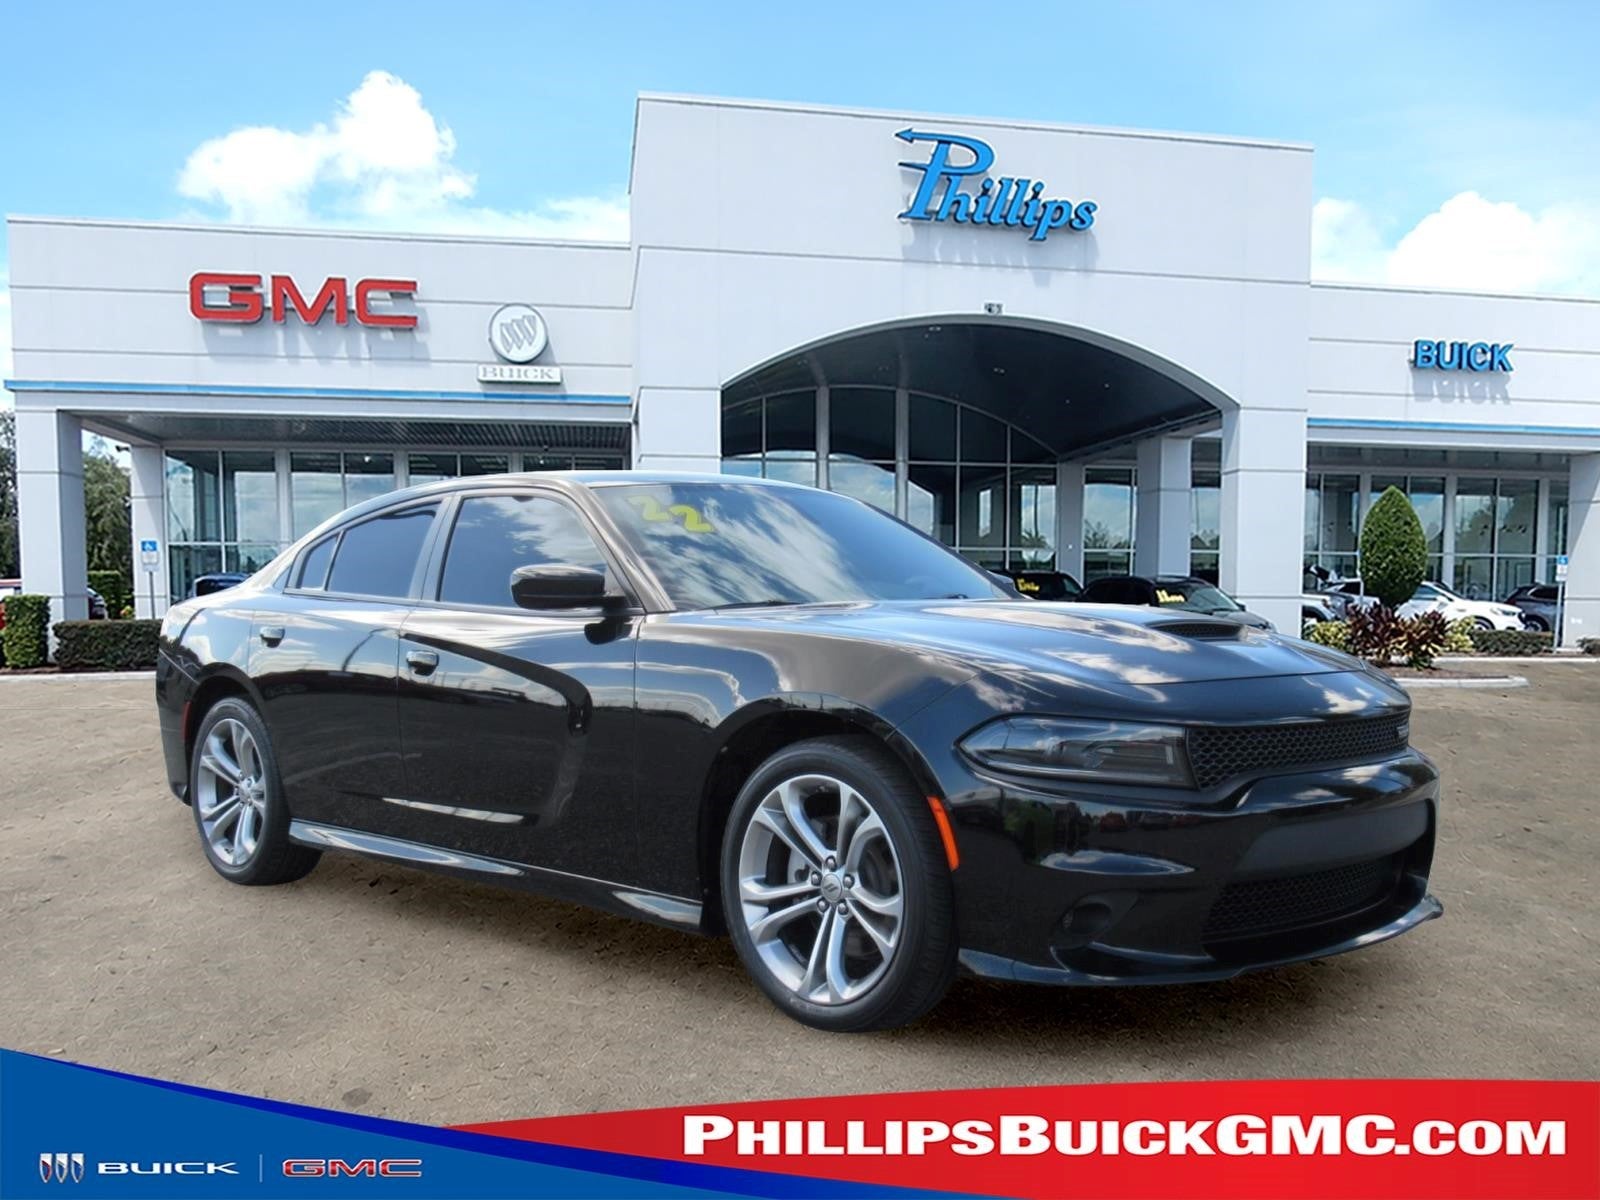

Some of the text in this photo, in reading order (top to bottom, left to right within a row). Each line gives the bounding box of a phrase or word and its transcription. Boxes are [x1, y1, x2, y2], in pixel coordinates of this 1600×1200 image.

[895, 127, 1098, 241] Phillips
[189, 271, 418, 329] GMC
[482, 366, 554, 380] BUICK
[1413, 340, 1514, 373] BUICK
